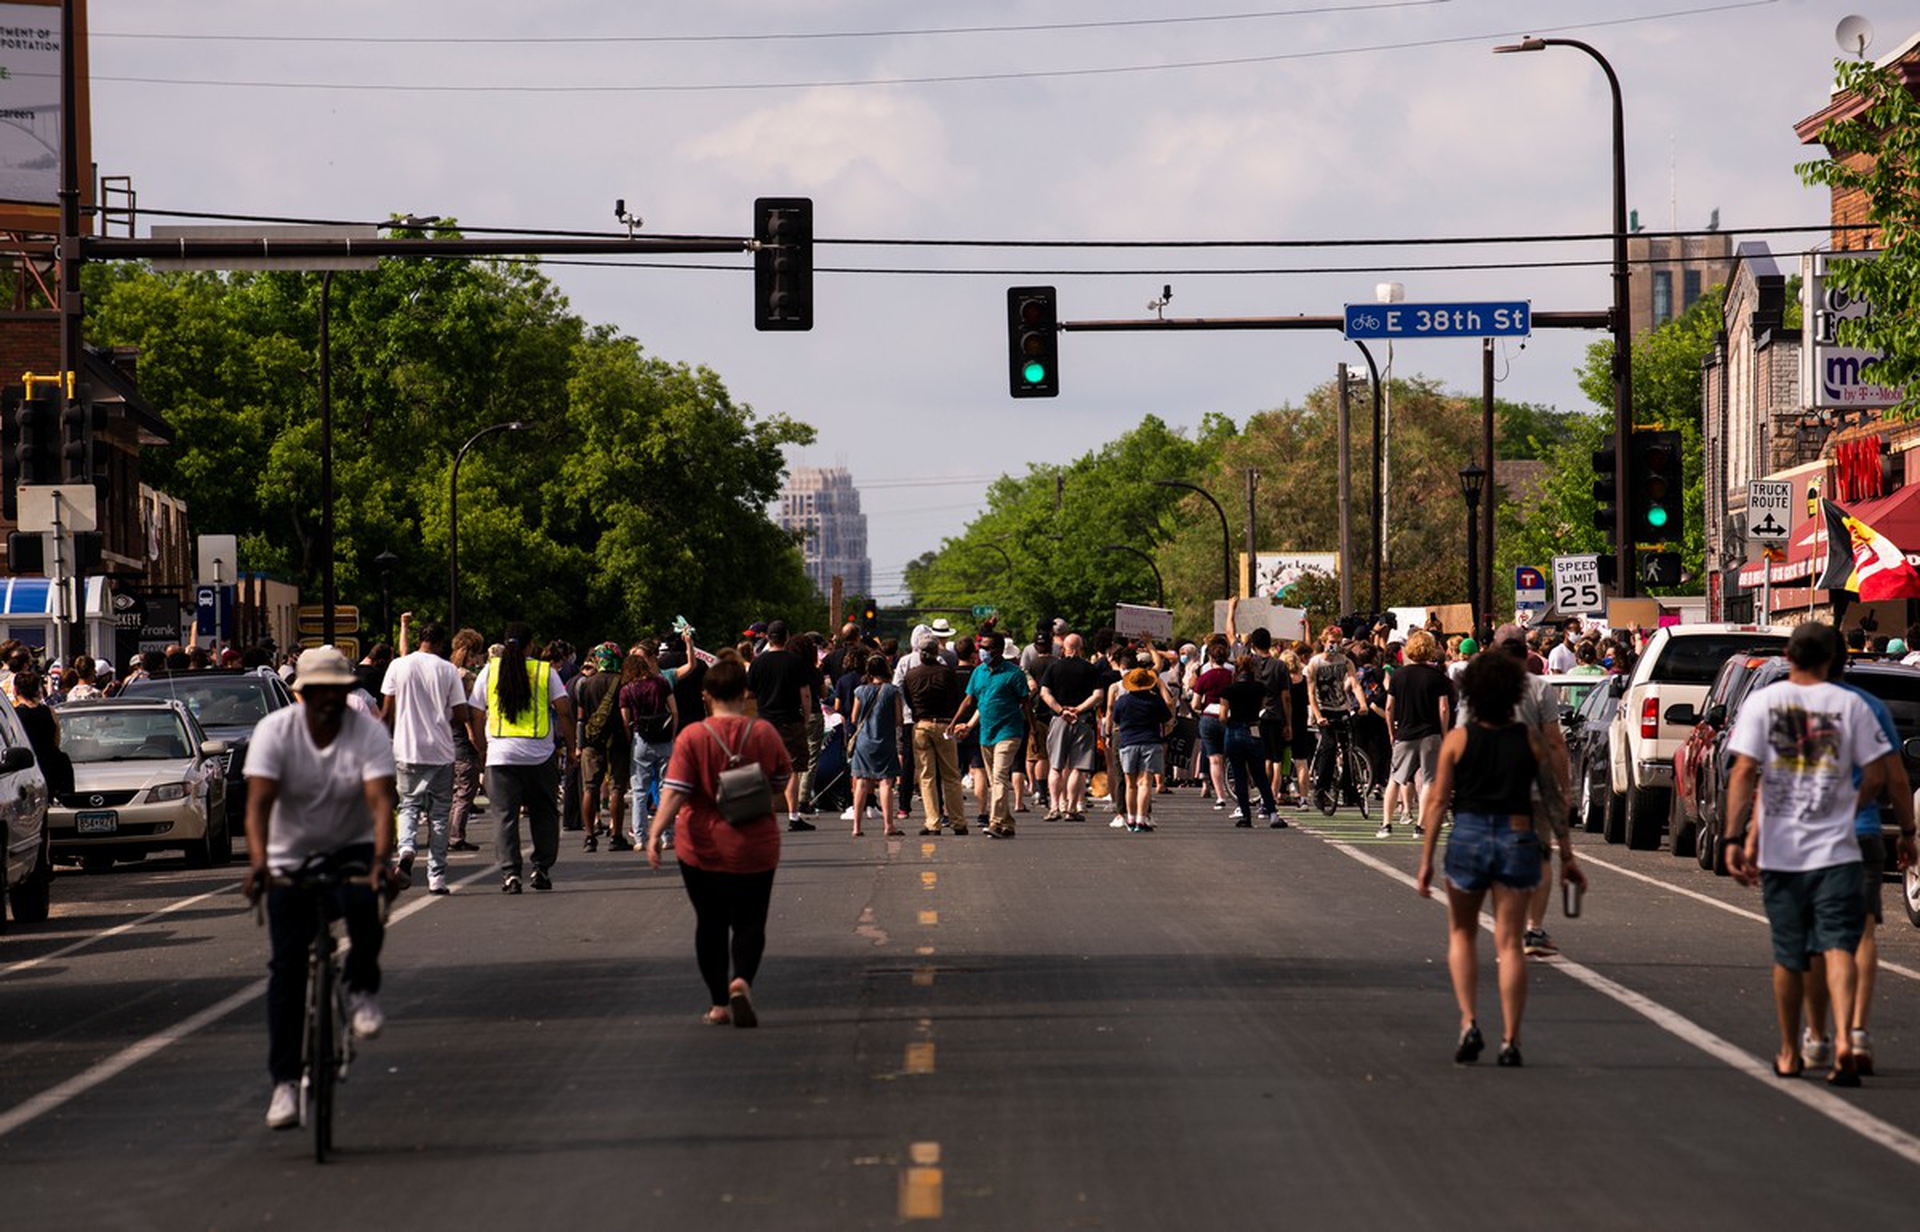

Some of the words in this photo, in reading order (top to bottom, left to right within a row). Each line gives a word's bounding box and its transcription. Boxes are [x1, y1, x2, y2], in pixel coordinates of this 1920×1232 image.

[37, 29, 50, 38] OF
[1387, 312, 1402, 331] E
[1416, 309, 1481, 331] 38th
[1494, 309, 1523, 329] St
[1753, 484, 1788, 495] TRUCK
[1751, 498, 1788, 508] ROUTE
[1558, 561, 1597, 572] SPEED
[1563, 573, 1593, 584] LIMIT
[1560, 585, 1599, 607] 25
